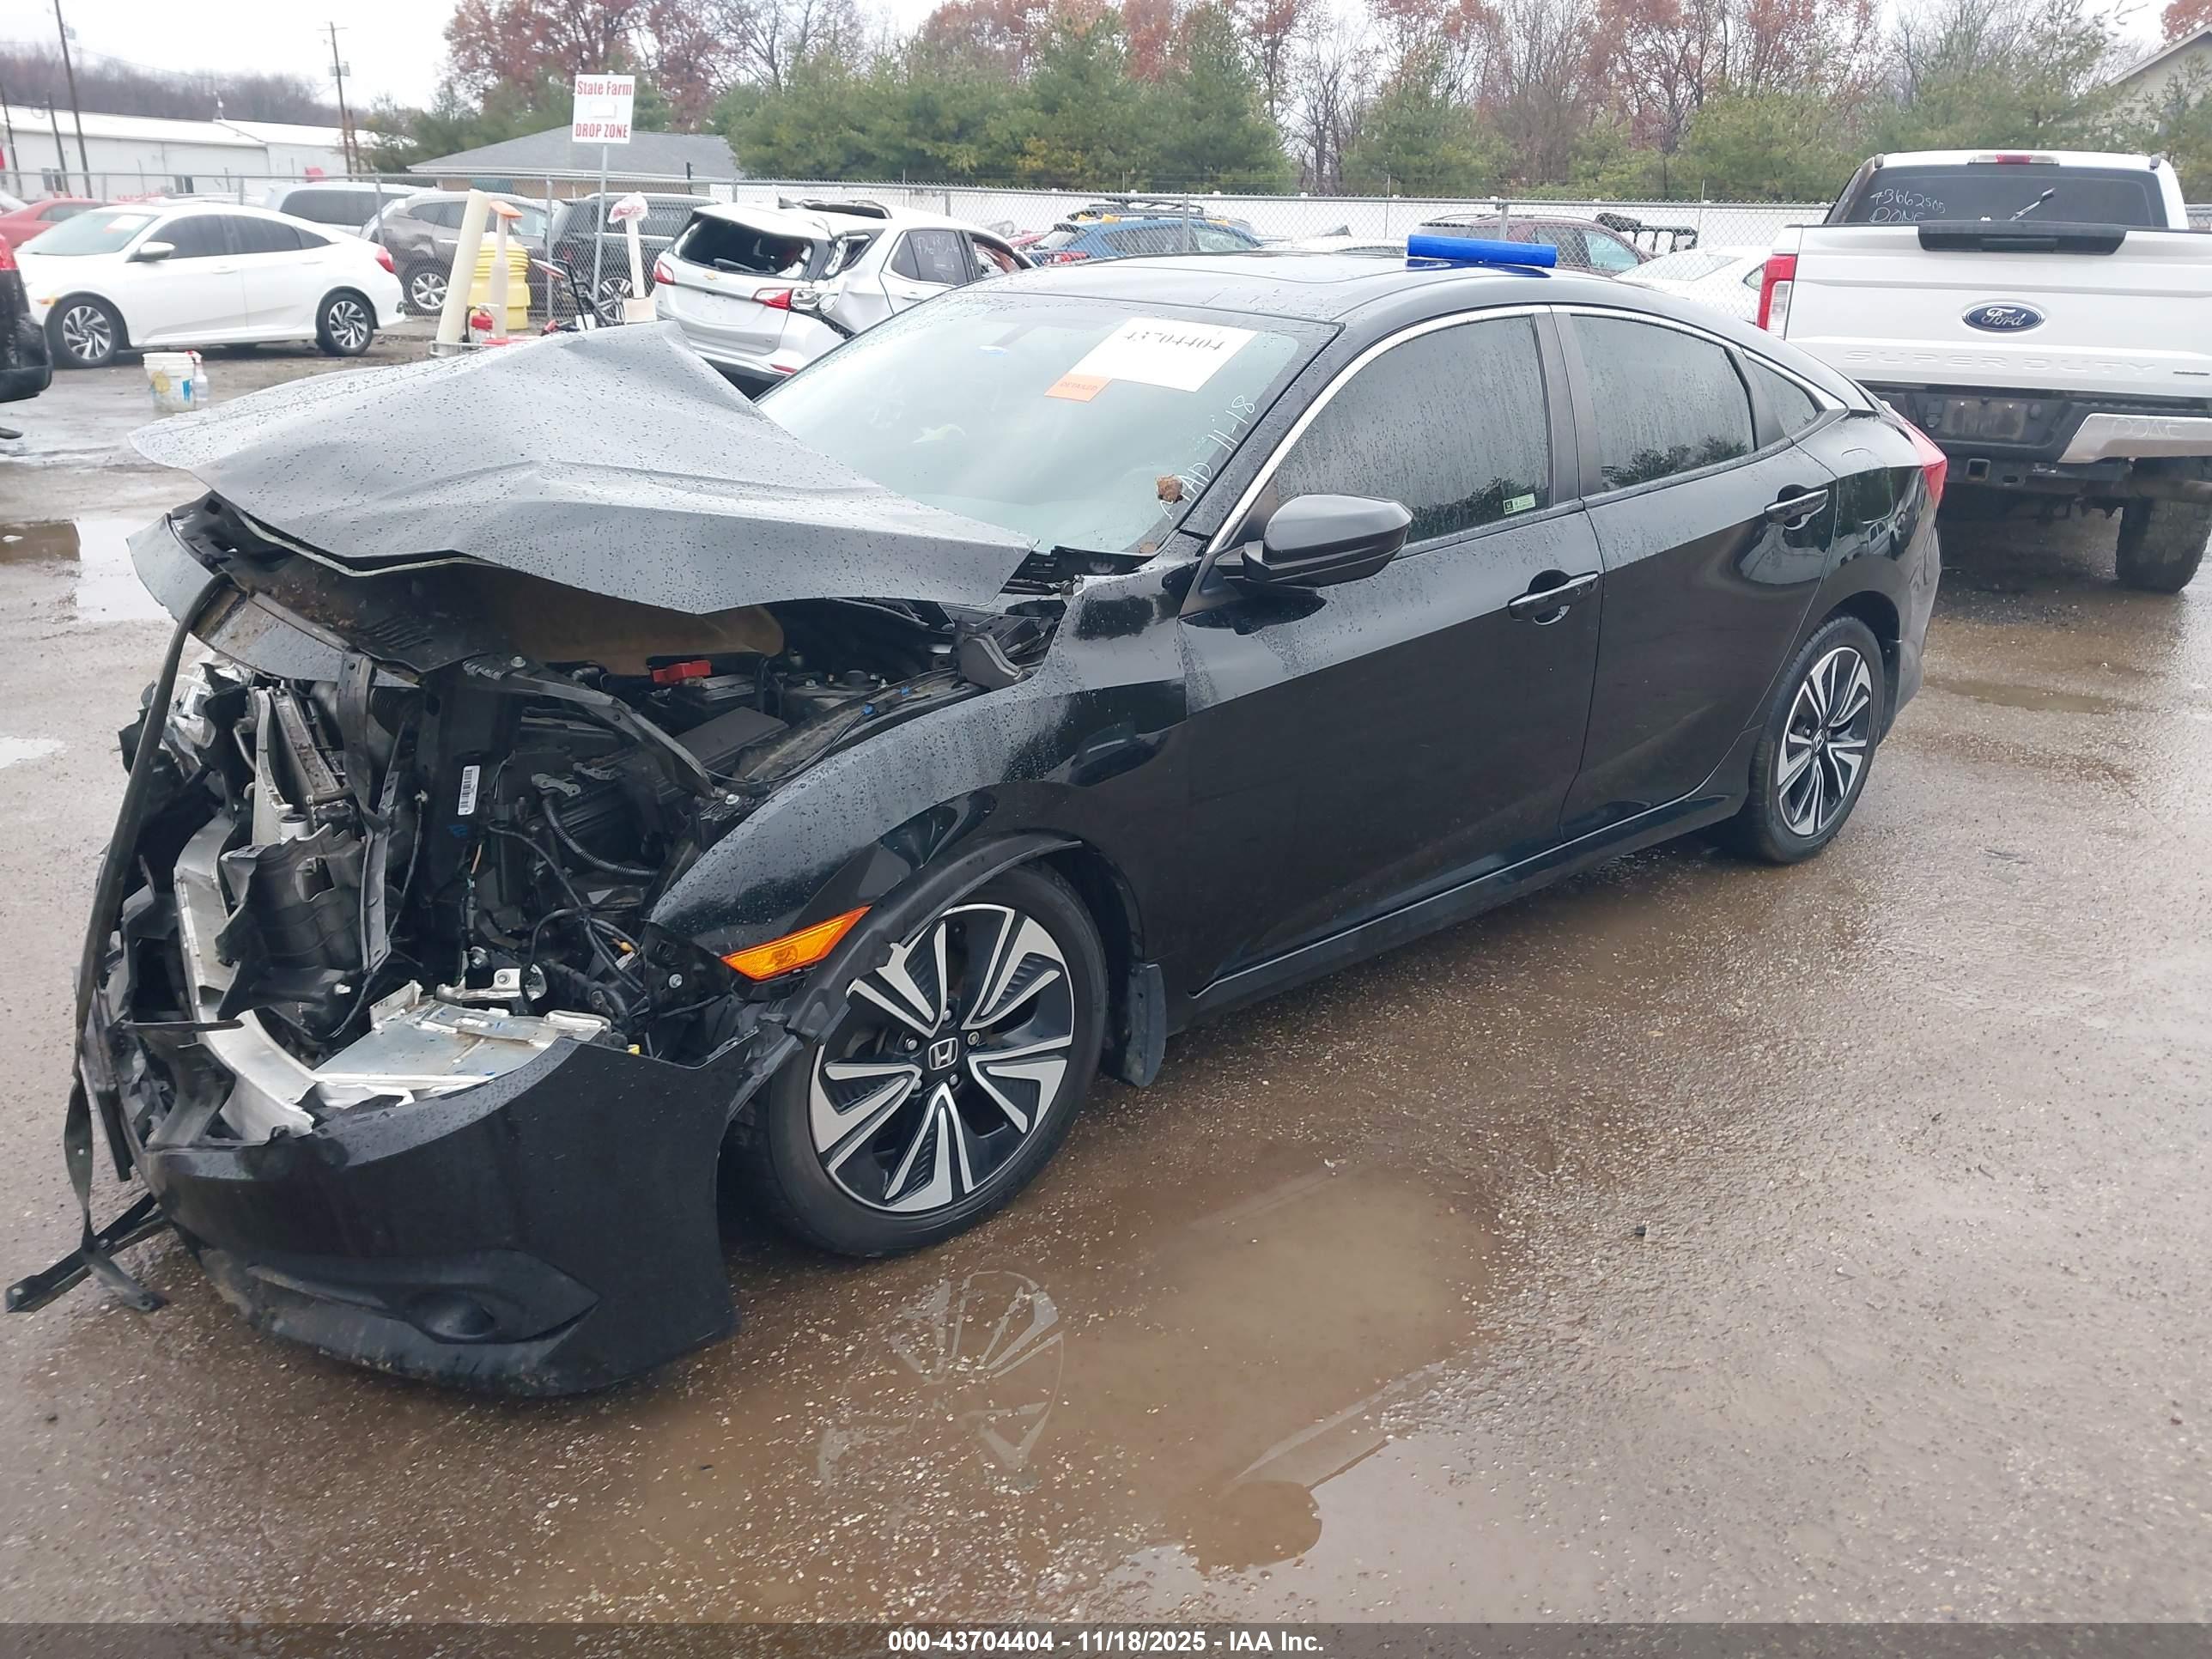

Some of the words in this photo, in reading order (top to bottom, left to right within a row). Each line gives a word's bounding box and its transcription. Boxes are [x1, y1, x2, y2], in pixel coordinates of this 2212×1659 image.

[576, 80, 604, 96] State
[606, 81, 633, 96] Farm
[574, 123, 602, 137] DROP
[604, 124, 629, 138] ZONE
[1980, 307, 2027, 326] Ford
[1844, 349, 2008, 368] SUPER
[2022, 357, 2156, 376] DUTY
